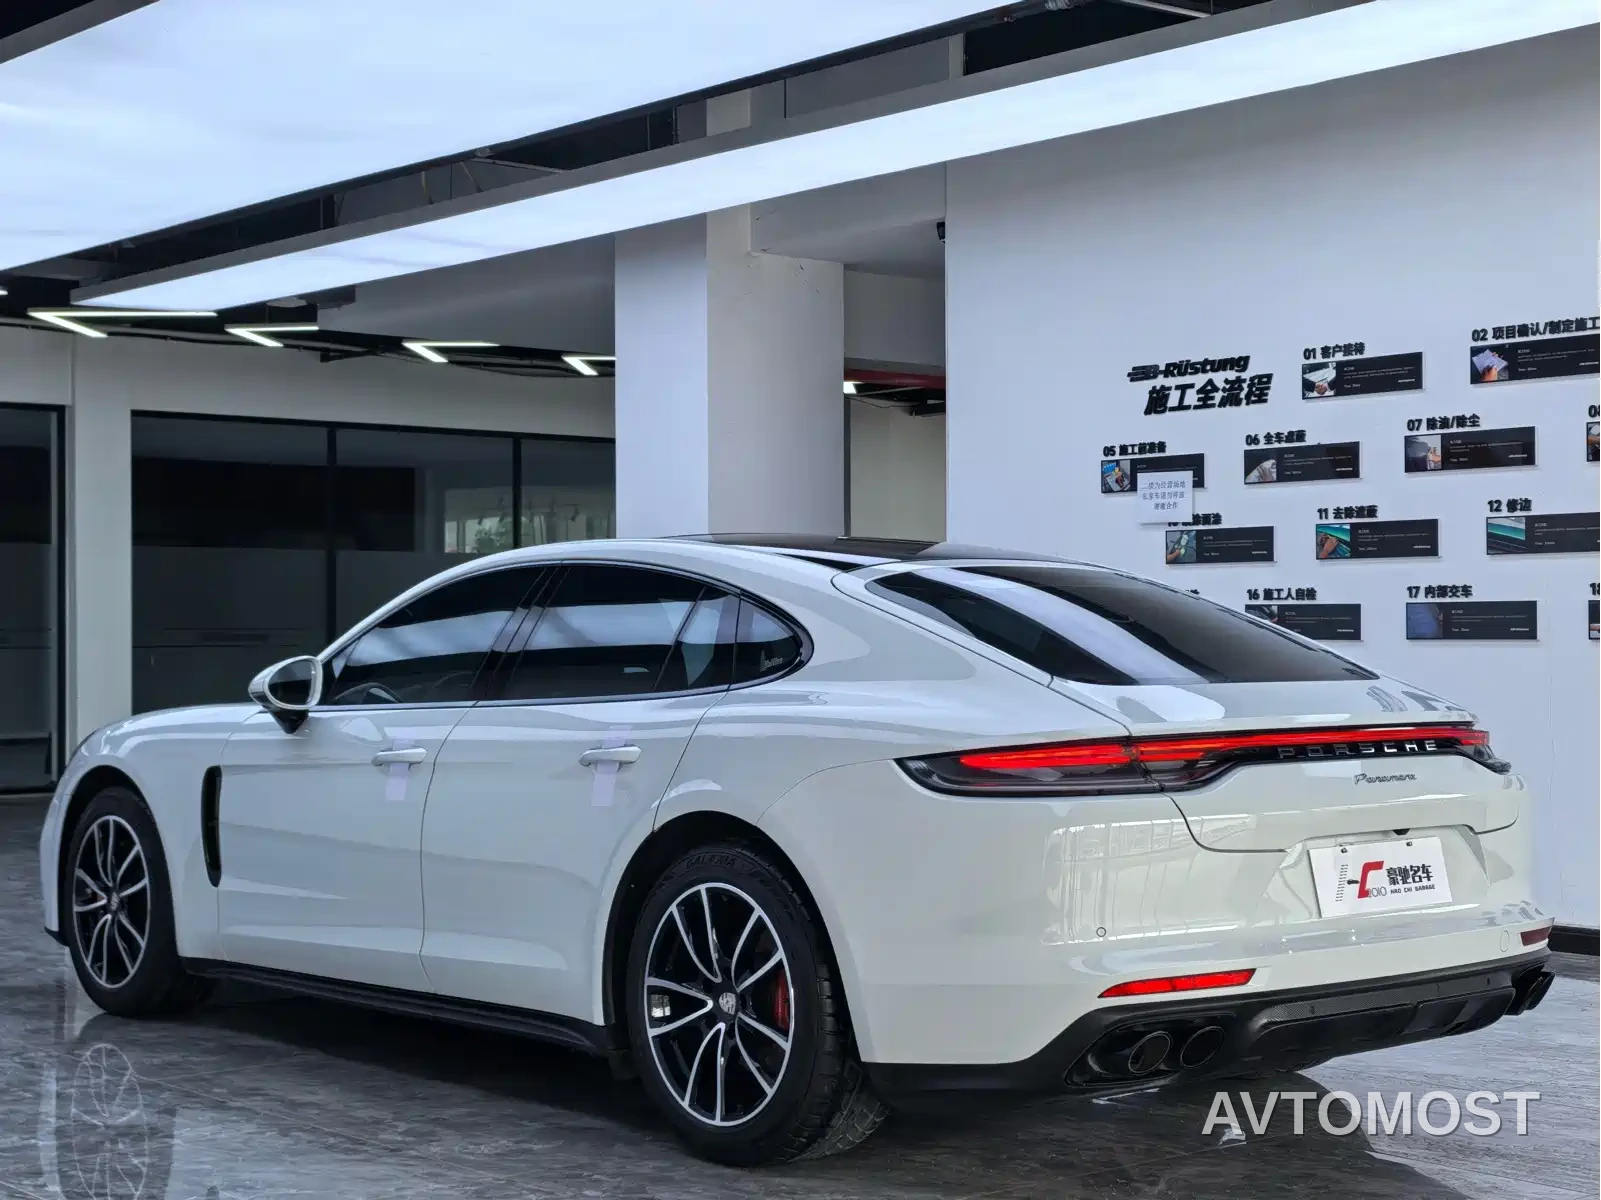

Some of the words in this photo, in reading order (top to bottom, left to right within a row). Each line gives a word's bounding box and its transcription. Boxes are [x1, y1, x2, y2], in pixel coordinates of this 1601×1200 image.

[1471, 329, 1488, 342] 02
[1303, 348, 1316, 360] 01
[1320, 342, 1365, 359] 客户接待
[1143, 373, 1273, 416] 施工全流程
[1407, 418, 1422, 431] 07
[1245, 434, 1260, 446] 06
[1103, 445, 1116, 457] 05
[1119, 441, 1167, 456] 施工前准备
[1317, 507, 1328, 520] 11
[1332, 504, 1378, 519] 去除遮蔽
[1488, 499, 1502, 513] 12
[1506, 498, 1532, 513] 修边
[1246, 588, 1260, 600] 16
[1407, 586, 1420, 599] 17
[1424, 584, 1473, 599] 内部交车
[1277, 740, 1437, 758] PORSCHE
[1354, 773, 1417, 785] Panamera
[1386, 864, 1433, 885] 豪驰名车
